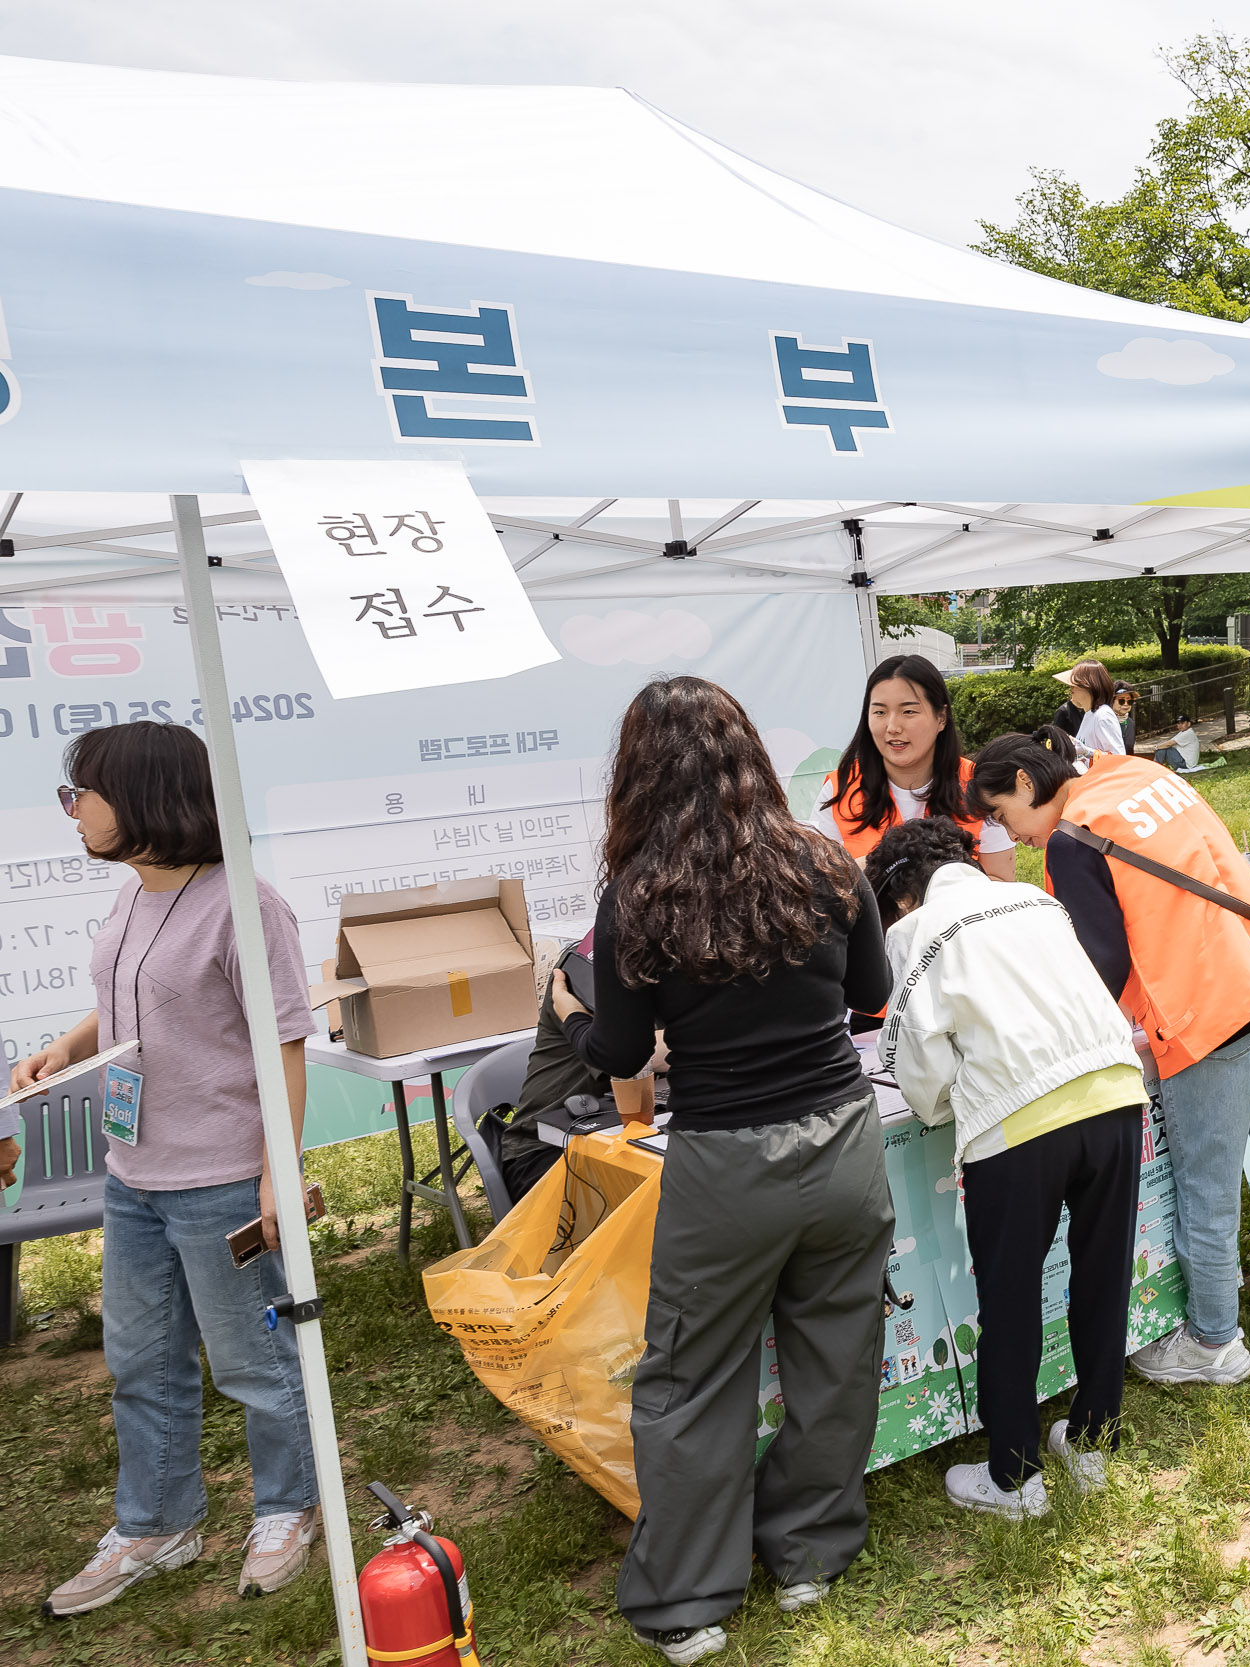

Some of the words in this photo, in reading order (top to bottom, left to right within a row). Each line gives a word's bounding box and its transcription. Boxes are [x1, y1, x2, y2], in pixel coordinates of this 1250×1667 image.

[316, 510, 447, 557] 현장
[349, 585, 486, 640] 접수
[984, 898, 1038, 919] ORIGINAL
[906, 940, 943, 987] ORIGINAL
[108, 1103, 133, 1124] Staff
[455, 1322, 517, 1334] 광진구
